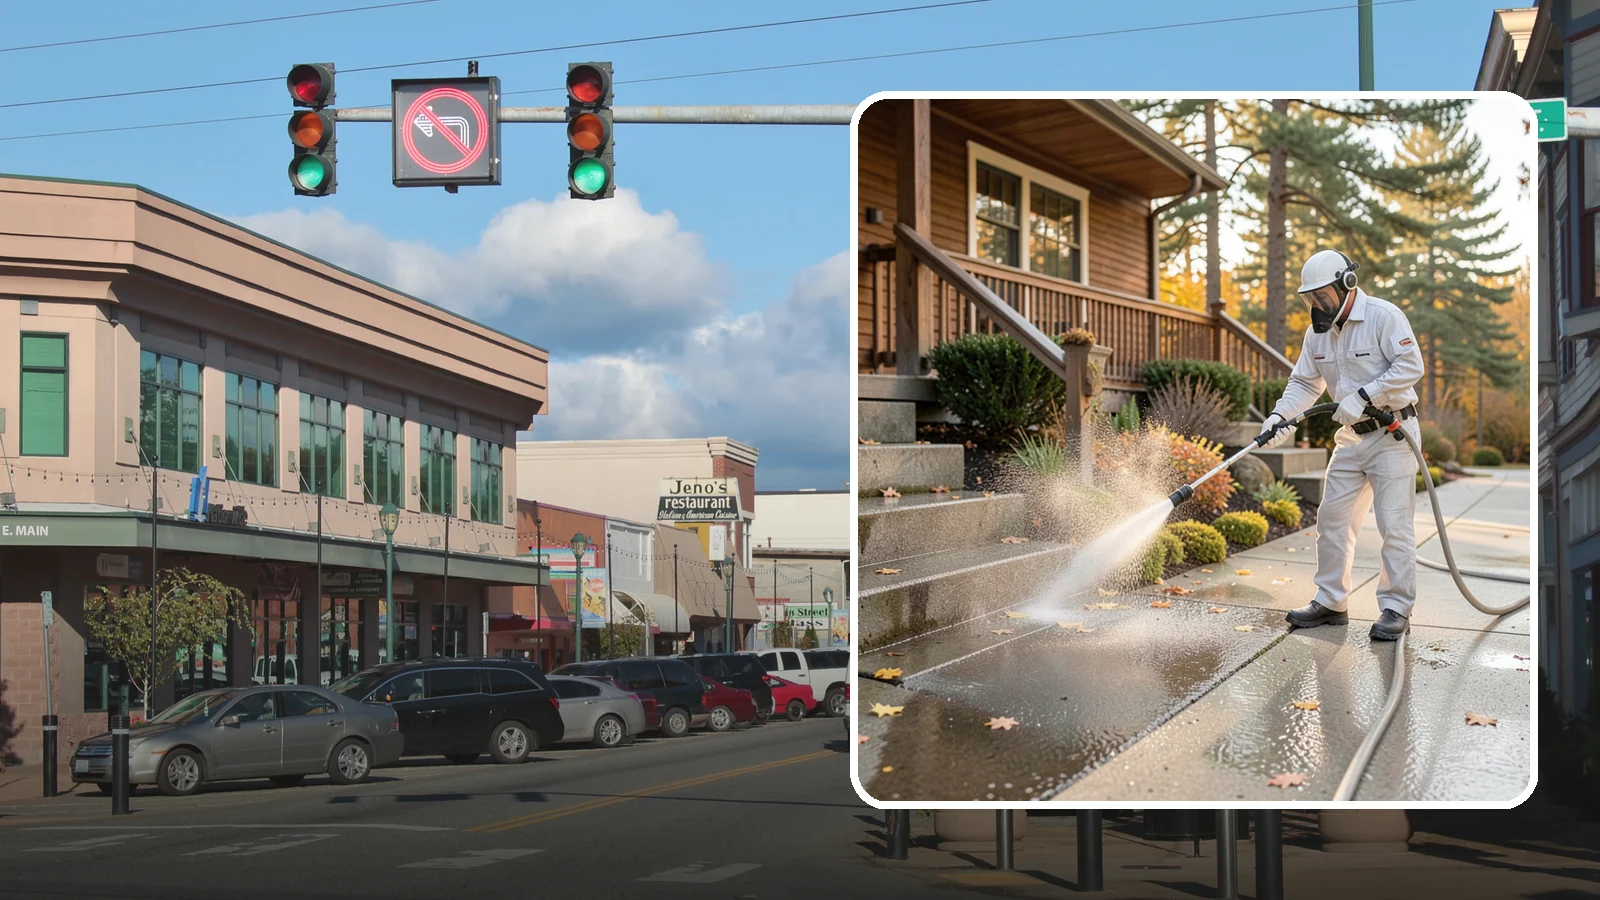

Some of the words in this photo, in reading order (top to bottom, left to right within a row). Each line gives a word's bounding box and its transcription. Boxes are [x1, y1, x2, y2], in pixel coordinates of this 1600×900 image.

[669, 480, 728, 494] Jeno's
[665, 496, 731, 509] restaurant
[659, 510, 682, 519] Italian
[686, 510, 715, 519] American
[715, 509, 738, 519] Cuisine
[2, 525, 13, 536] E.
[15, 525, 49, 536] MAIN
[798, 607, 828, 617] Street
